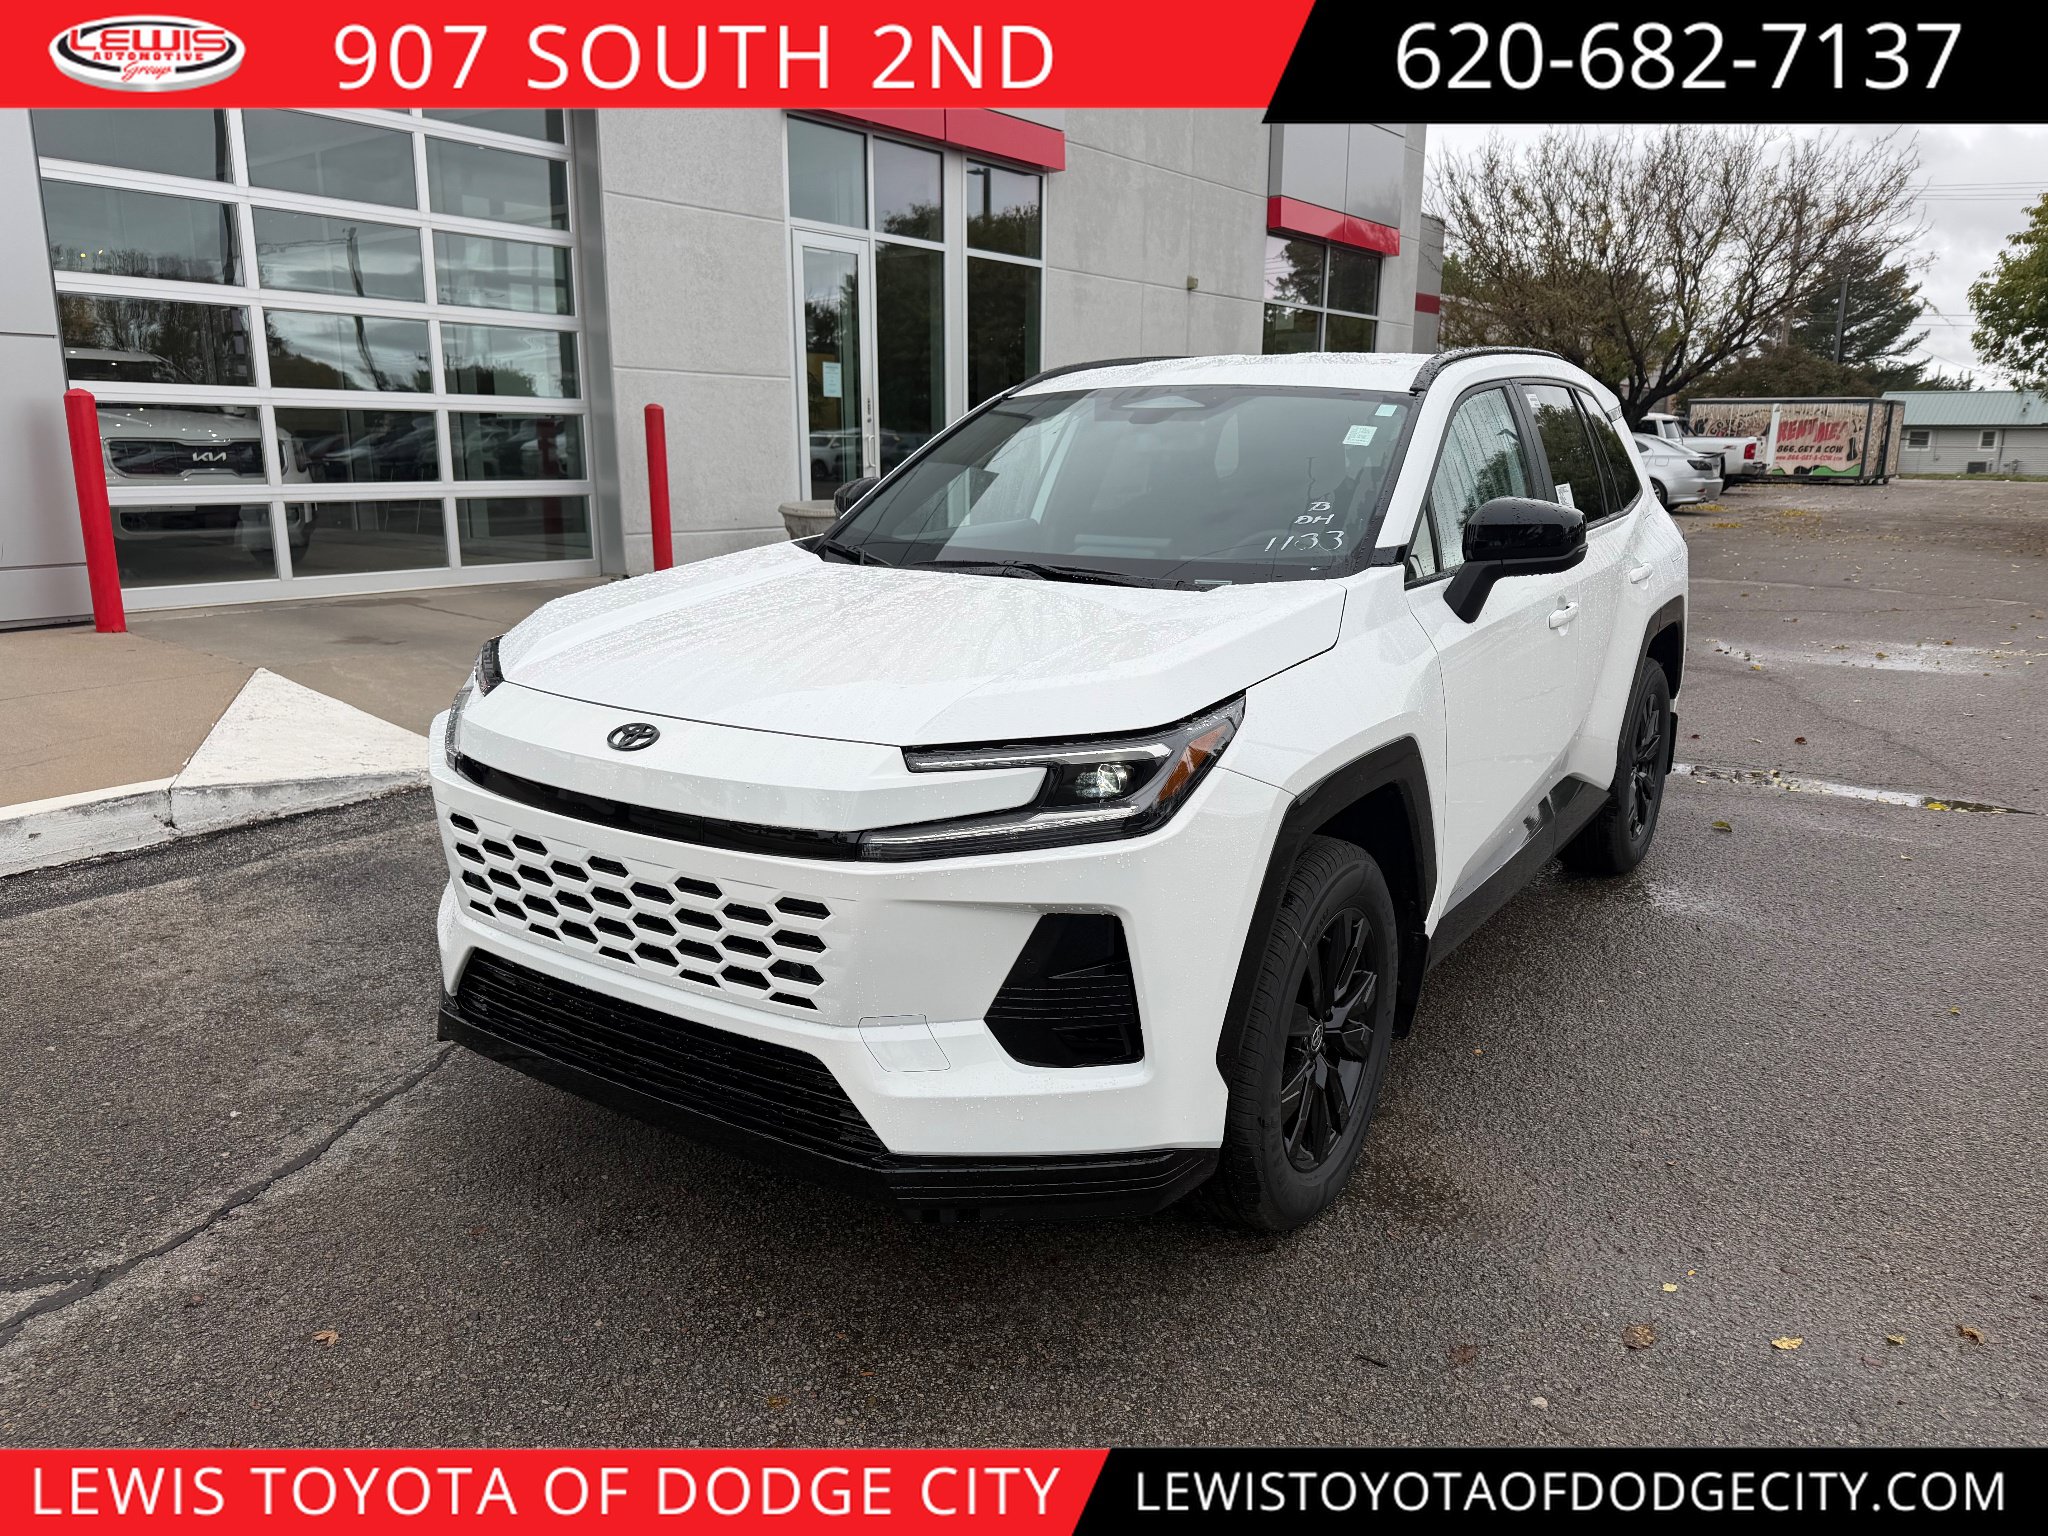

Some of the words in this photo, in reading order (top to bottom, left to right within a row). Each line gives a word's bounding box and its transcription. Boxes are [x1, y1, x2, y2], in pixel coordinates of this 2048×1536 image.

[1777, 417, 1819, 443] RENT
[192, 451, 227, 462] KIA
[1824, 445, 1844, 453] COW
[1265, 531, 1345, 552] 1133
